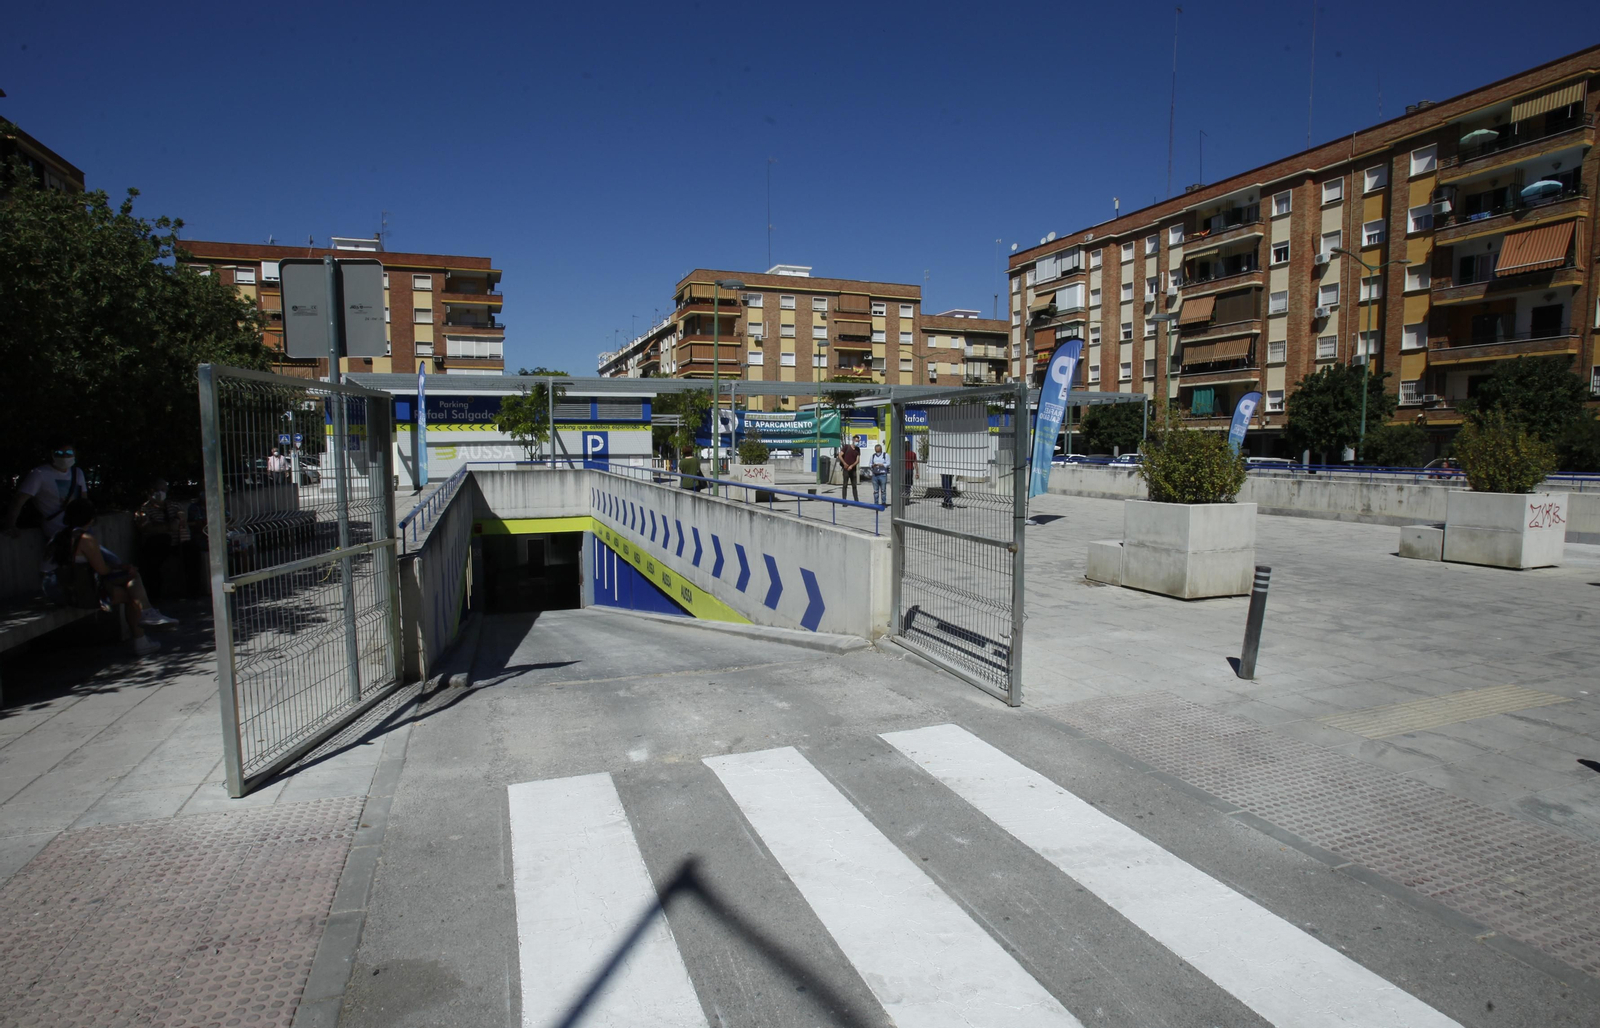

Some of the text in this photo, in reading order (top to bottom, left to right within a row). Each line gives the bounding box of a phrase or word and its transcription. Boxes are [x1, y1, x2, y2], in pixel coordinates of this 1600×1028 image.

[440, 400, 468, 410] Parking
[414, 409, 494, 422] Rfael Salgado
[458, 444, 514, 459] AUSSA
[587, 434, 604, 461] P
[662, 572, 672, 590] AUSSA
[681, 584, 693, 605] AUSSA
